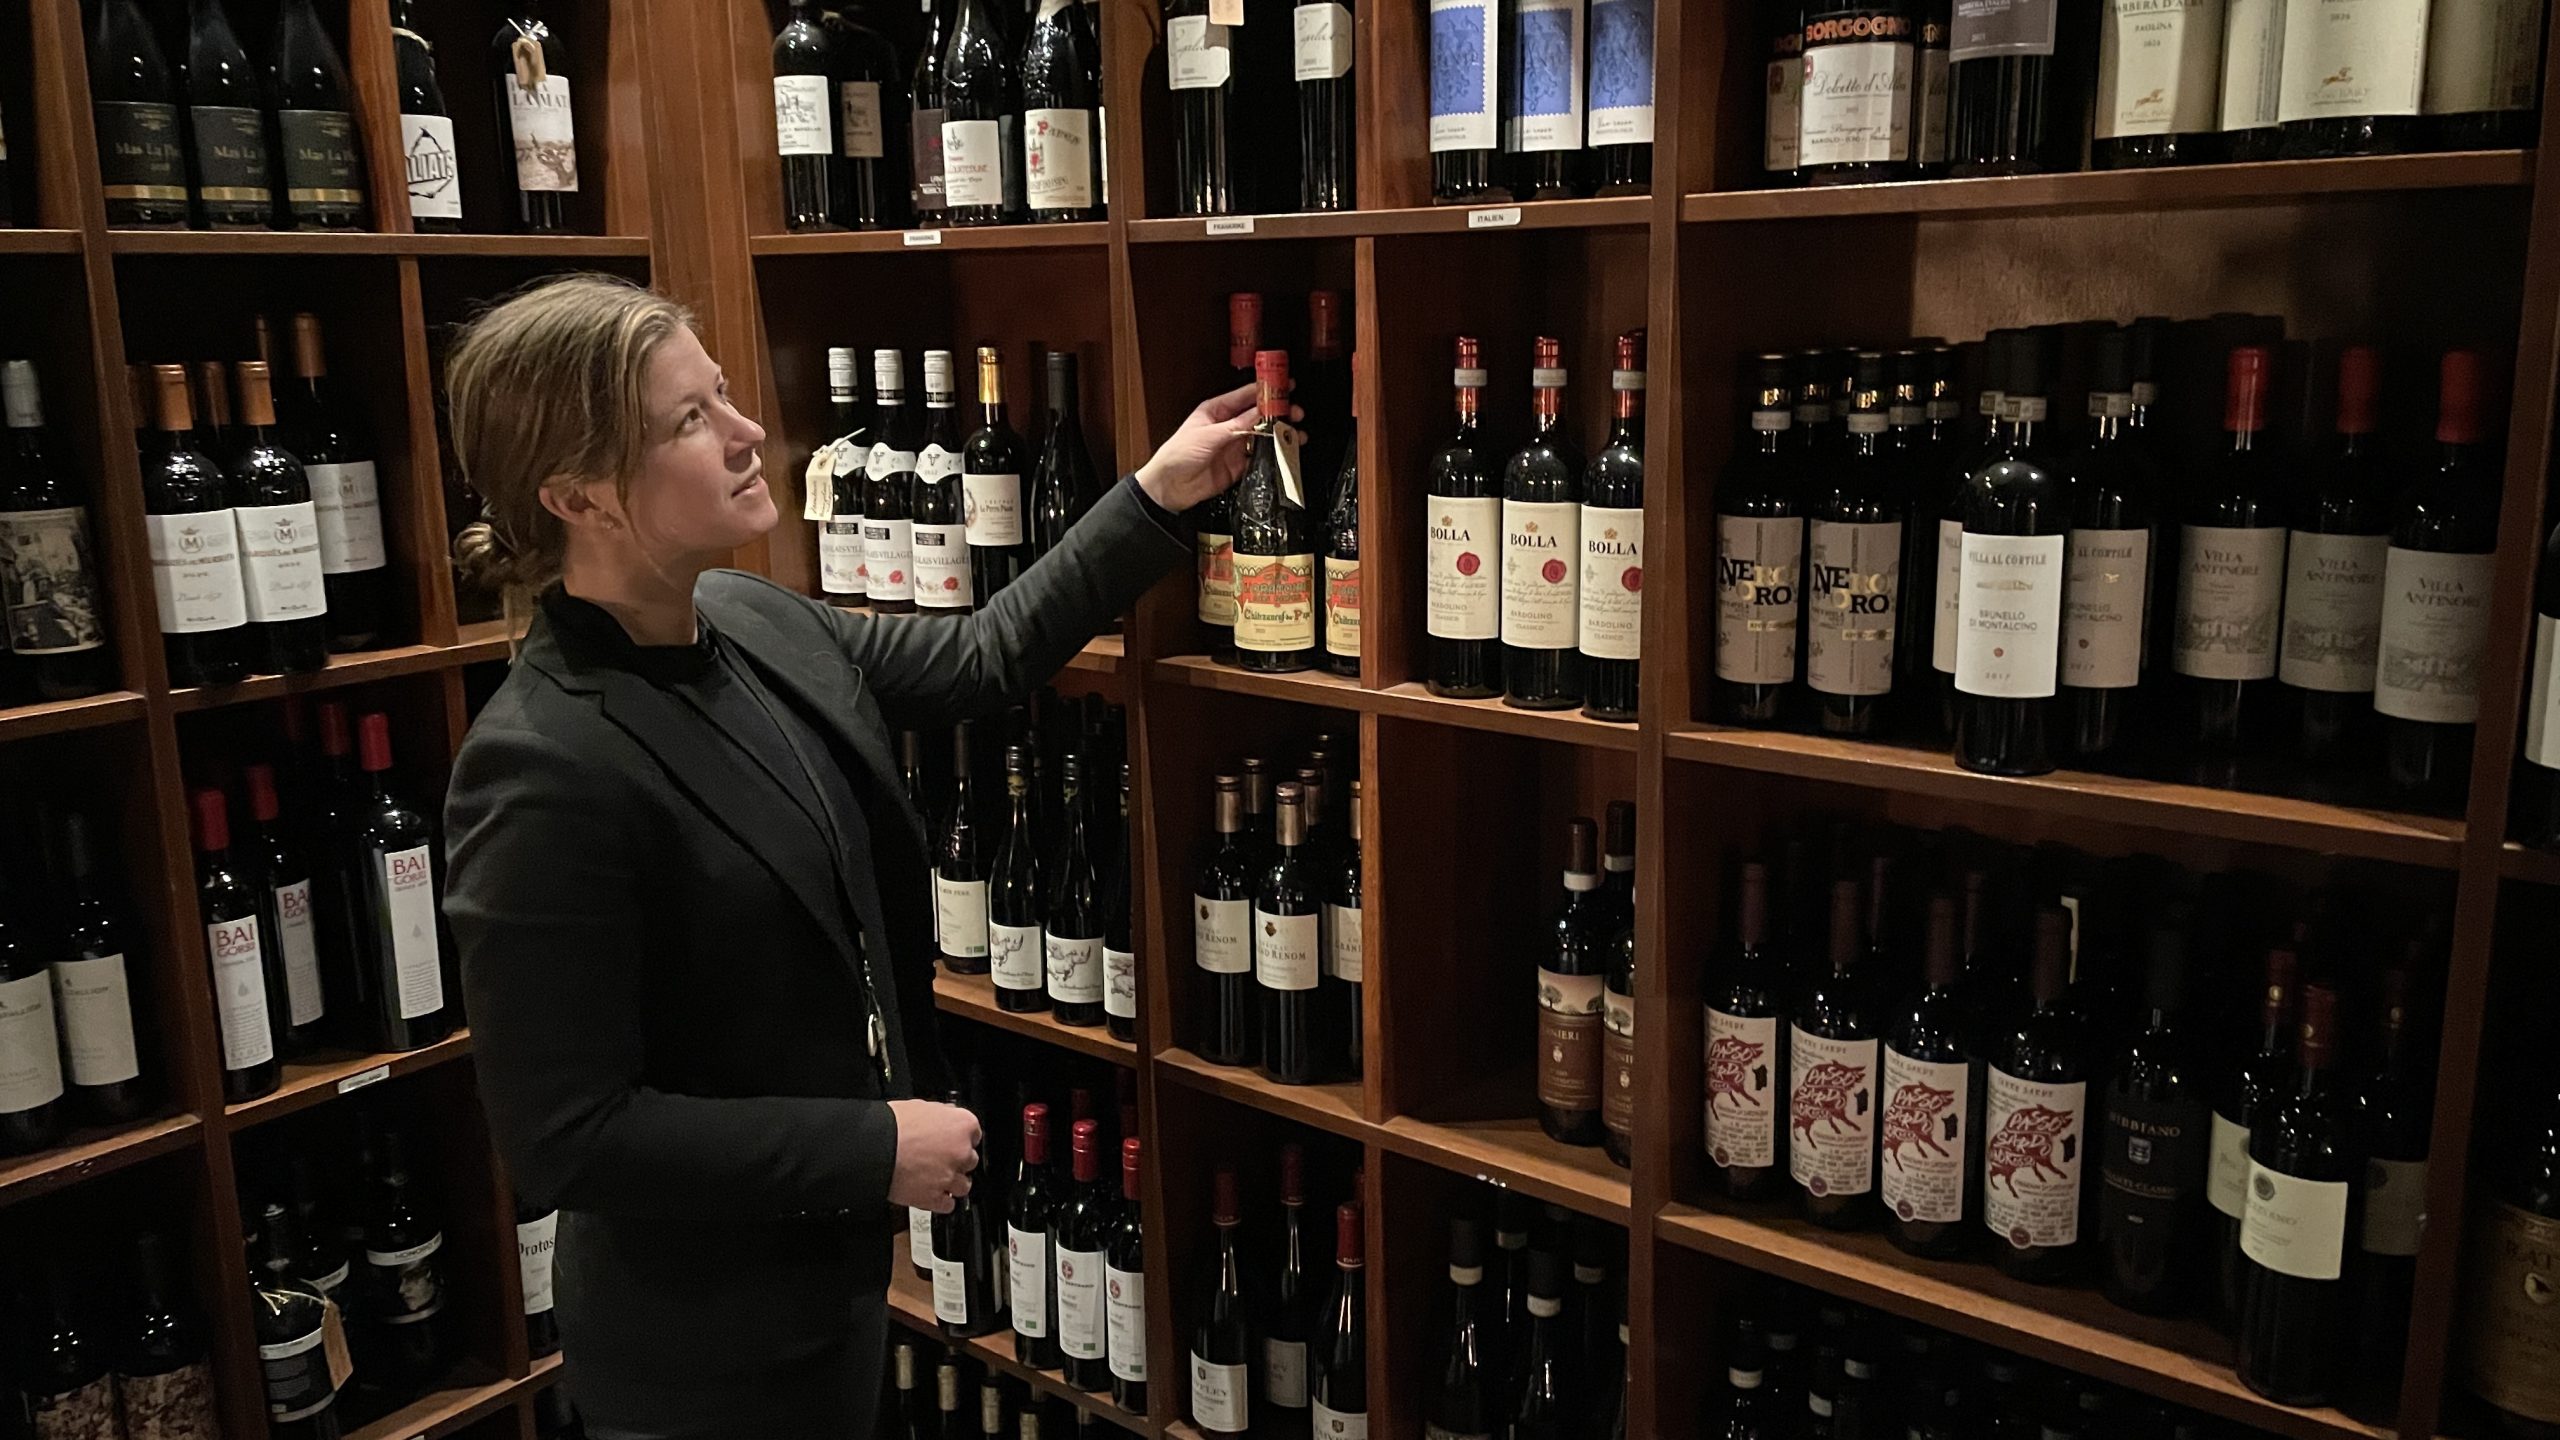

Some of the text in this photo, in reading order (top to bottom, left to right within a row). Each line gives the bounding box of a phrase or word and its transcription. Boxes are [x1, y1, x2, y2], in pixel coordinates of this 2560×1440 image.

[1477, 213, 1504, 223] ITALIEN
[1430, 526, 1471, 542] BOLLA
[1510, 533, 1558, 548] BOLLA
[1588, 540, 1638, 556] BOLLA
[2204, 548, 2244, 563] VILLA
[1992, 553, 2003, 565] AL
[2317, 557, 2359, 570] VILLA
[1719, 556, 1788, 587] NERO
[2193, 562, 2260, 577] ANTINORI
[1813, 564, 1889, 594] NERO
[2418, 577, 2465, 593] VILLA
[1736, 582, 1792, 606] ORO
[1831, 588, 1890, 614] ORO
[1510, 609, 1553, 620] BARDOLINO
[1979, 608, 2025, 621] BRUNELLO
[1588, 619, 1633, 630] BARDOLINO
[1969, 618, 2038, 631] DI MONTALCINO
[391, 853, 427, 875] BAI
[215, 923, 255, 948] BAI
[1205, 933, 1237, 944] RENOM
[1271, 950, 1307, 961] RENOM
[1711, 1041, 1753, 1062] PASSO
[1808, 1066, 1856, 1087] PASSO
[1799, 1086, 1846, 1110] SARDO
[1896, 1087, 1945, 1111] PASSO
[1885, 1106, 1934, 1134] SARDO
[2009, 1110, 2062, 1132] PASSO
[1994, 1131, 2052, 1156] SARDO
